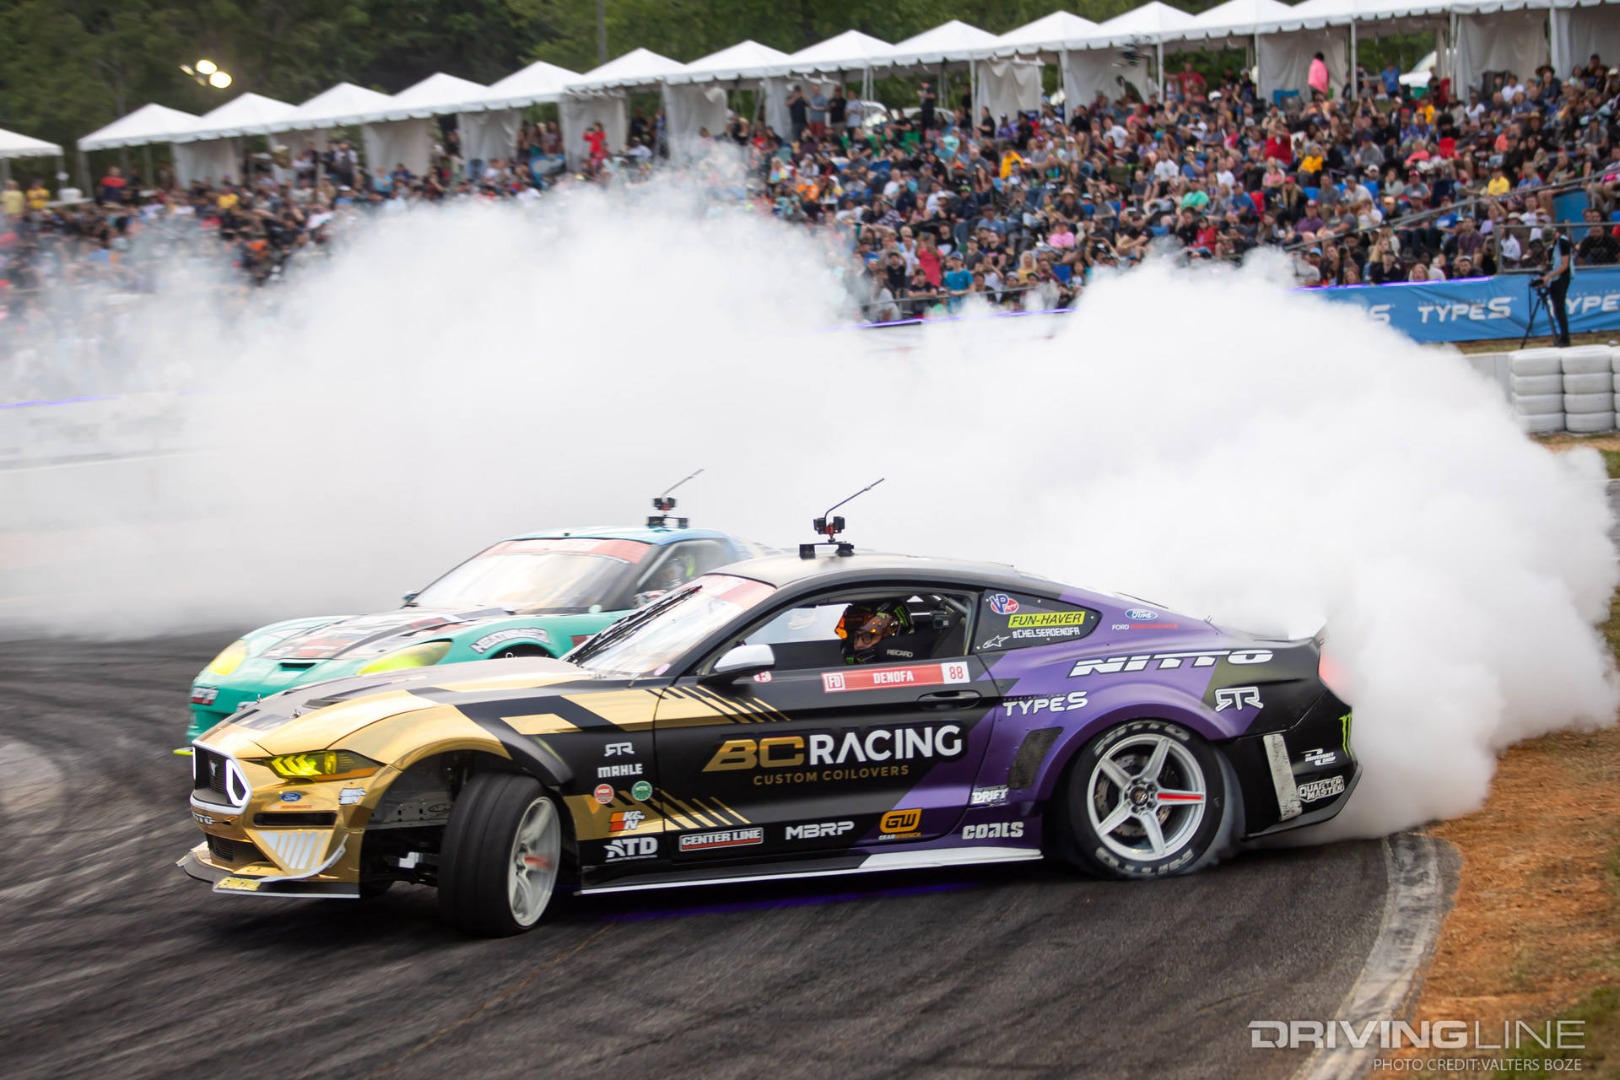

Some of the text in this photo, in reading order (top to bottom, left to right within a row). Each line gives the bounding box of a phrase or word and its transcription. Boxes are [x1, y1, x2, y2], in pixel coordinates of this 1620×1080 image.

[1010, 613, 1082, 626] FUN-HAVER
[886, 649, 913, 658] RECARO
[1067, 649, 1273, 677] NITTO
[873, 670, 914, 684] DENOFA
[949, 666, 964, 680] 88
[809, 725, 962, 765] RACING
[597, 763, 643, 779] MAHLE
[753, 765, 909, 786] CUSTOM COILOVERS
[1300, 778, 1343, 797] QUARTER
[1307, 785, 1343, 800] MASTER
[682, 829, 762, 846] CENTER LINE
[785, 821, 855, 840] MBRP
[603, 837, 658, 858] ATD
